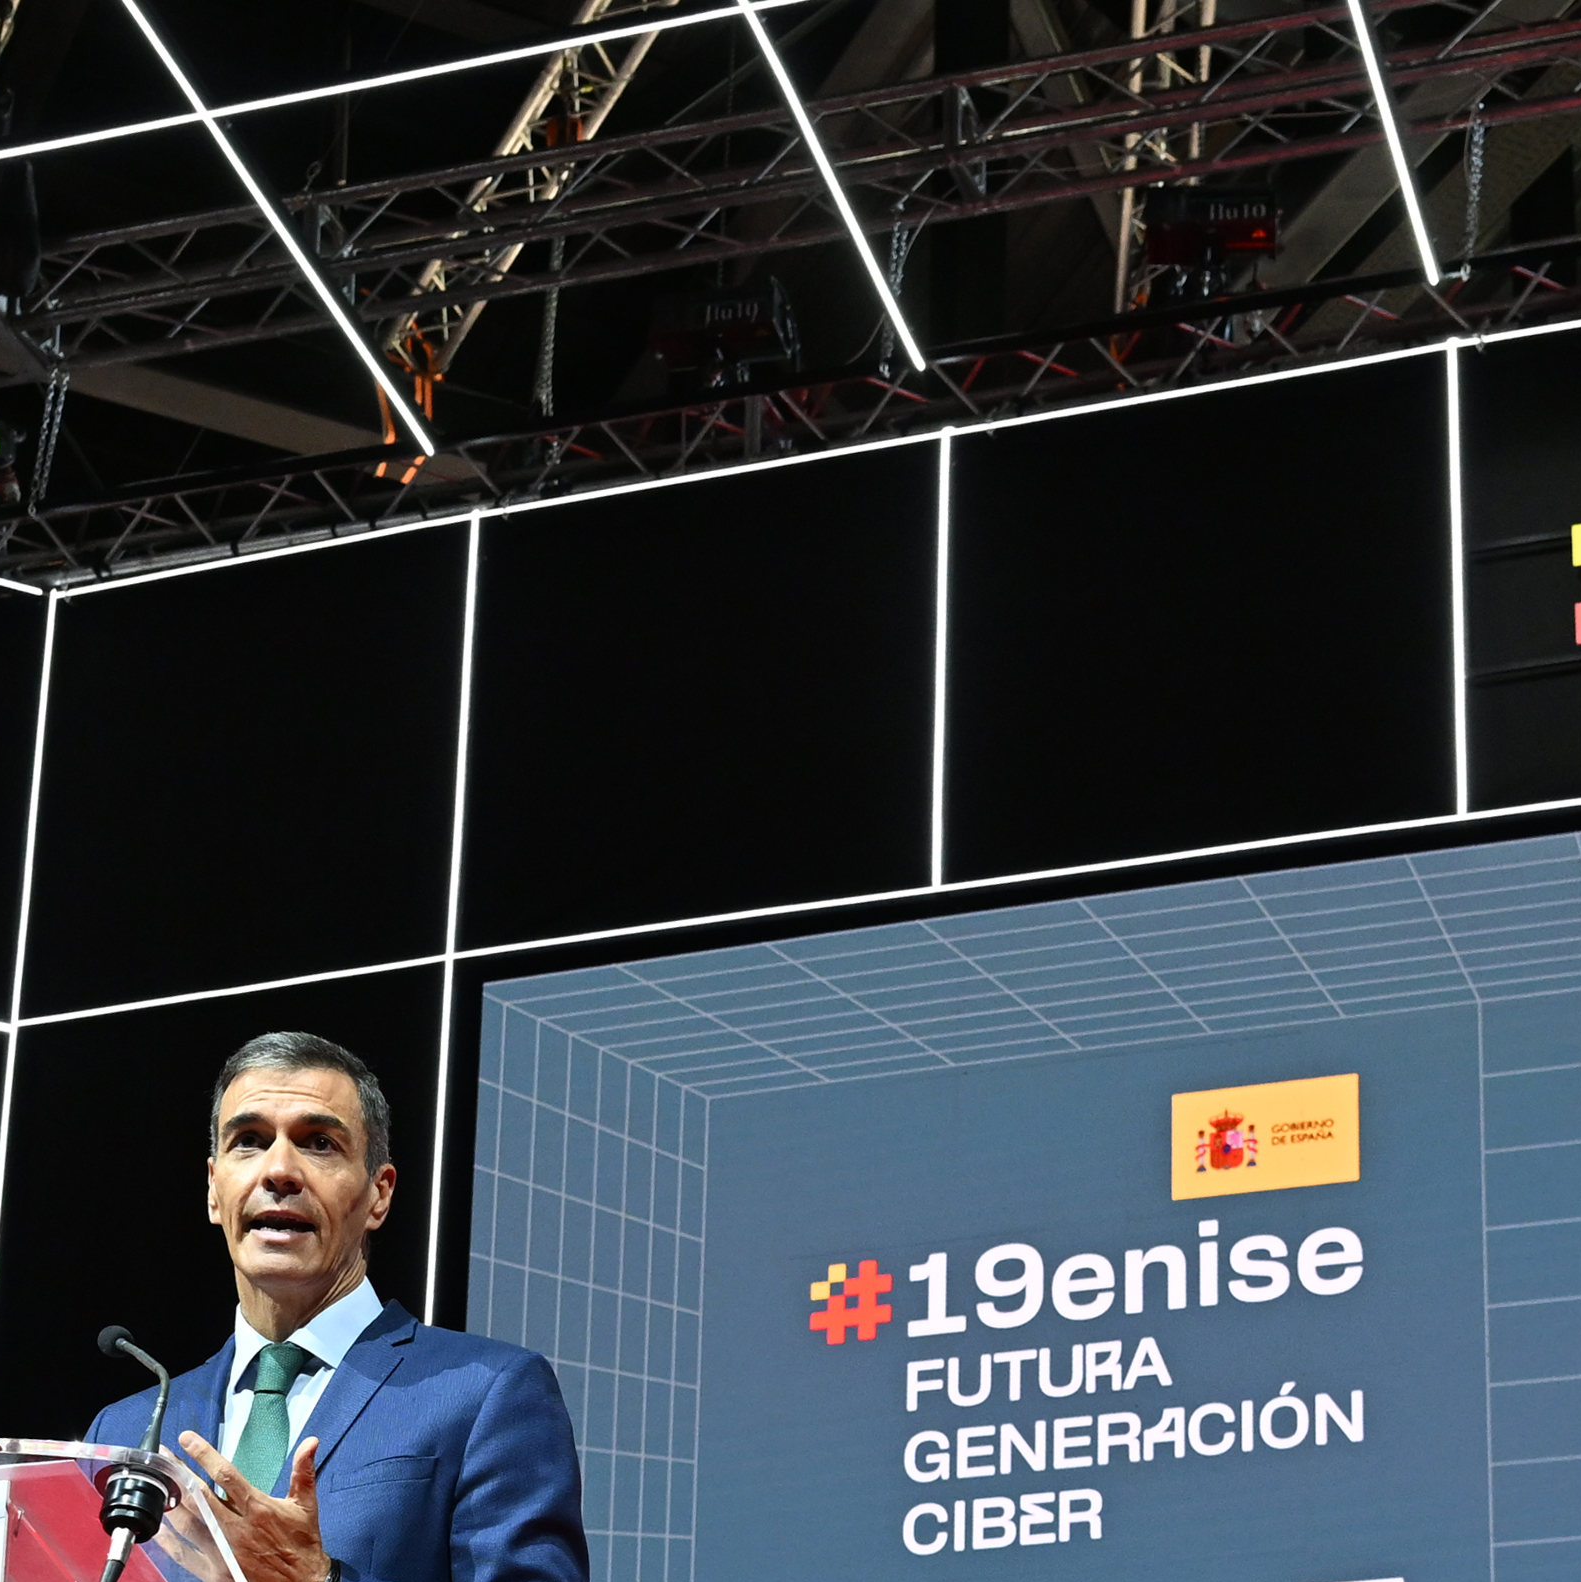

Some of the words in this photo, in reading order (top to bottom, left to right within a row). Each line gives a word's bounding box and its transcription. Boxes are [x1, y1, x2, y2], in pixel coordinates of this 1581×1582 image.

[810, 1219, 1364, 1345] #19enise
[906, 1336, 1173, 1412] FUTURA
[903, 1381, 1364, 1483] GENERACIÓN
[902, 1488, 1103, 1556] CIBER
